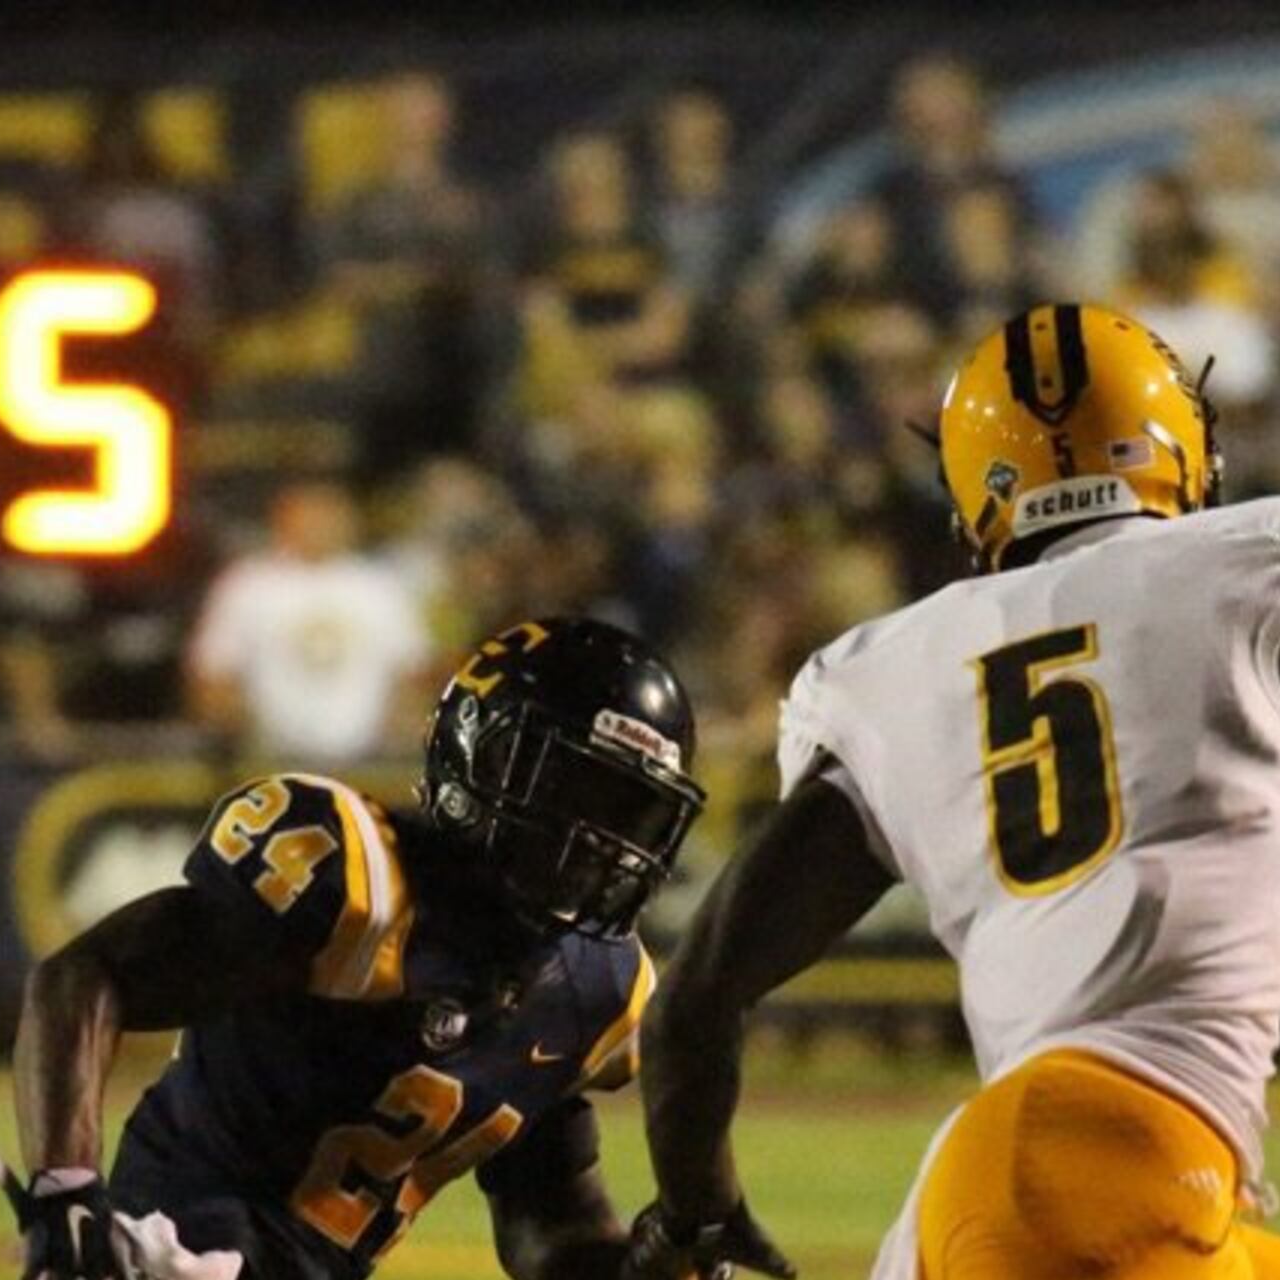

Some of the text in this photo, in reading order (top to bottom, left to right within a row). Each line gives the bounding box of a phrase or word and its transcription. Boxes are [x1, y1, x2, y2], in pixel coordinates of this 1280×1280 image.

[1024, 481, 1120, 521] schutt
[1052, 431, 1076, 479] 5
[966, 621, 1126, 901] 5
[210, 778, 340, 914] 24
